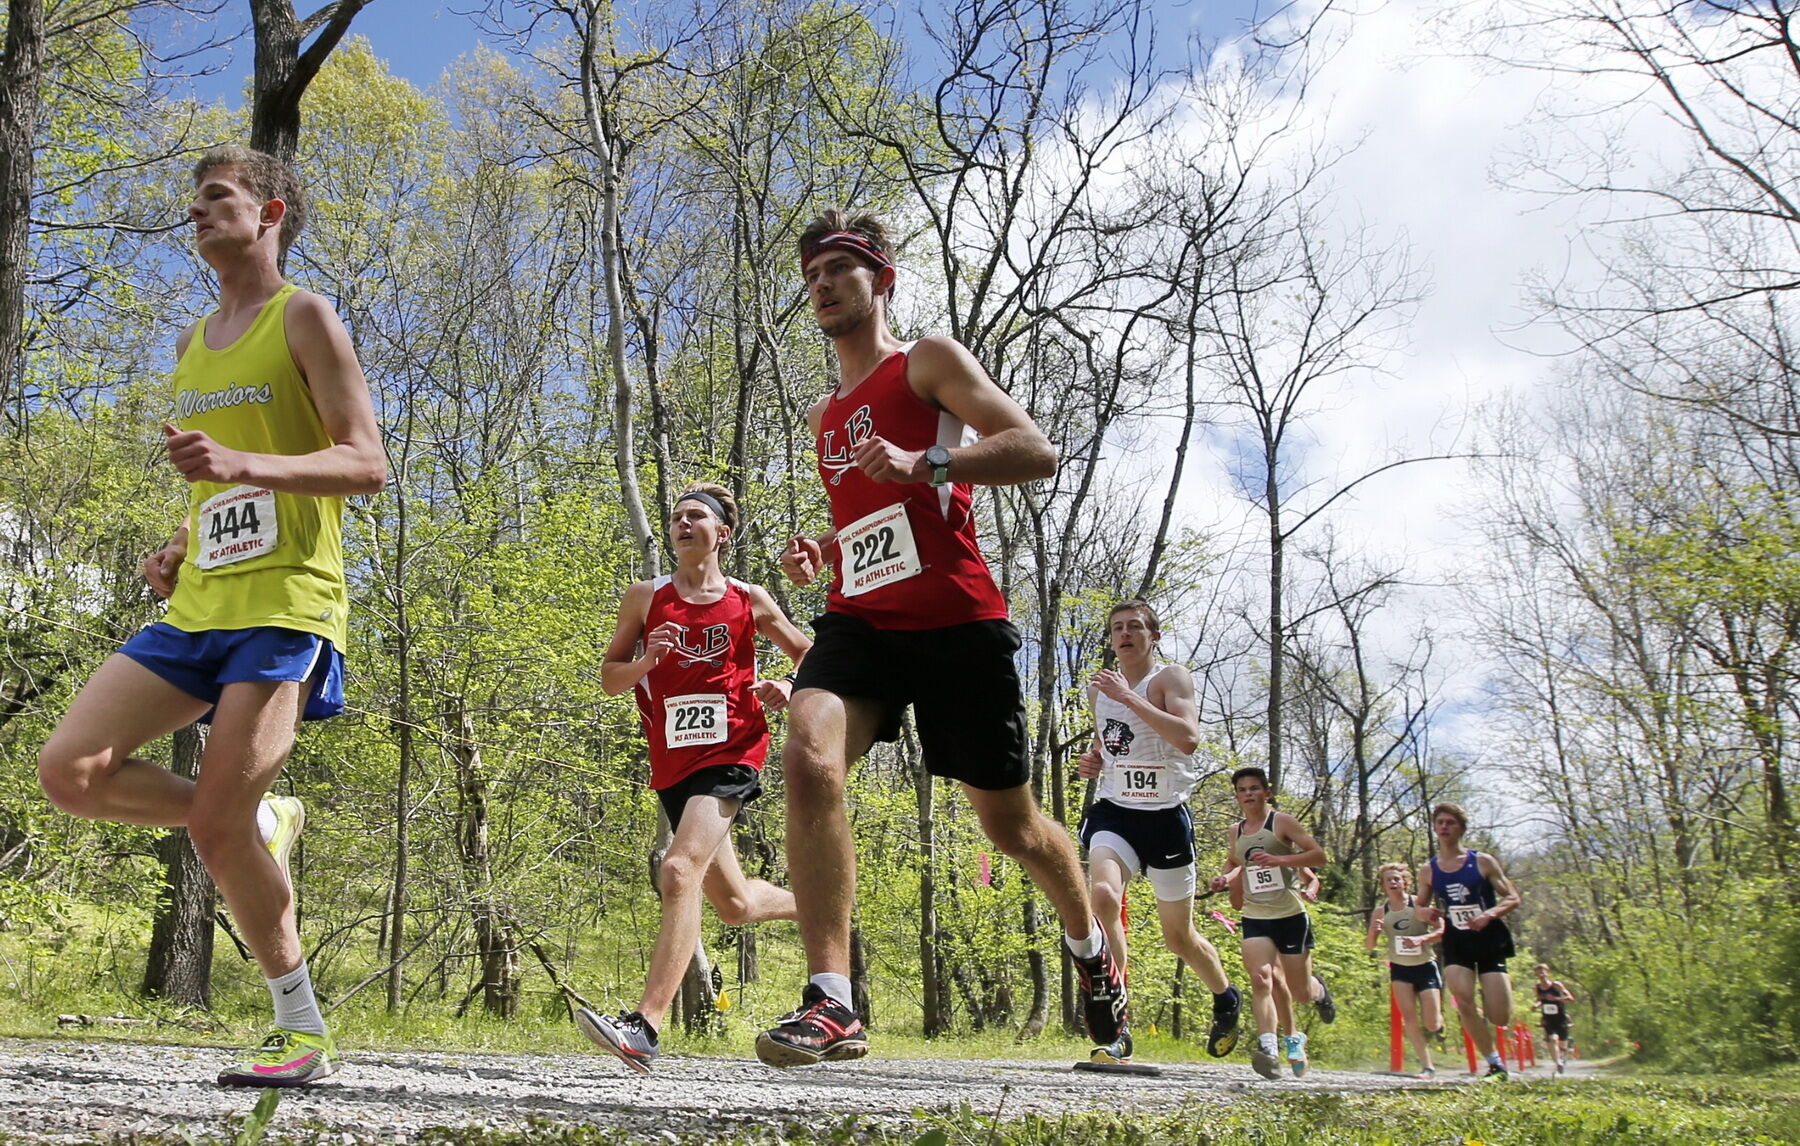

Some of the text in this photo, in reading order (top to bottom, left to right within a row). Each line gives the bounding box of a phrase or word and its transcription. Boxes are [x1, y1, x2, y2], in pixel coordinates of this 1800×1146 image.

[178, 383, 273, 420] Warriors
[208, 501, 260, 544] 444
[219, 538, 264, 557] ATHLETIC
[852, 526, 900, 574] 222
[865, 561, 906, 584] ATHLETIC
[679, 623, 730, 655] LB
[675, 706, 715, 731] 223
[684, 732, 717, 741] ATHLETIC
[1124, 770, 1157, 790] 194
[1256, 870, 1272, 884] 95
